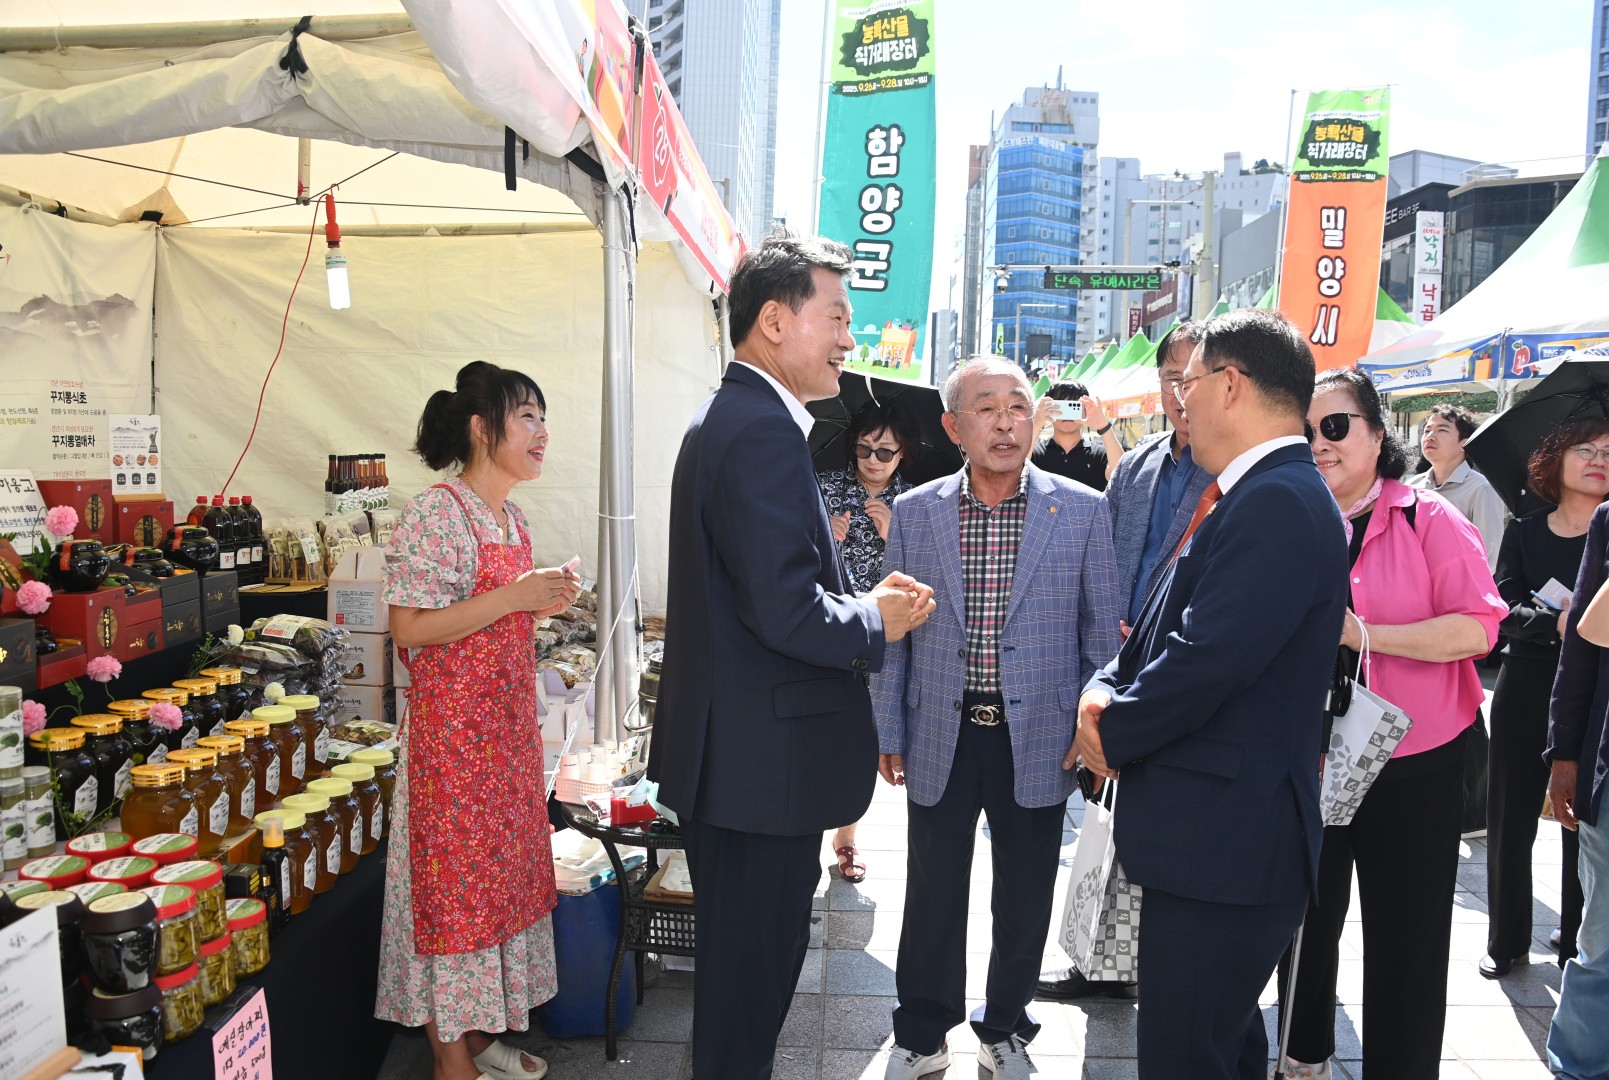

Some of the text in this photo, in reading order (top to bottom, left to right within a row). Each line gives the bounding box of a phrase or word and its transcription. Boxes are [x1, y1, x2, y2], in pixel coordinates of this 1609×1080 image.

[862, 15, 909, 43] 농특산물
[854, 37, 917, 66] 직거래장터
[1315, 124, 1365, 142] 농특산물
[1307, 142, 1368, 160] 직거래장터
[850, 123, 906, 291] 함양군
[1398, 205, 1411, 220] BAR
[1423, 235, 1440, 268] 낙지
[1055, 275, 1160, 289] 단속 유예시간은
[1309, 206, 1346, 346] 밀양시
[50, 391, 87, 404] 꾸지뽕식초
